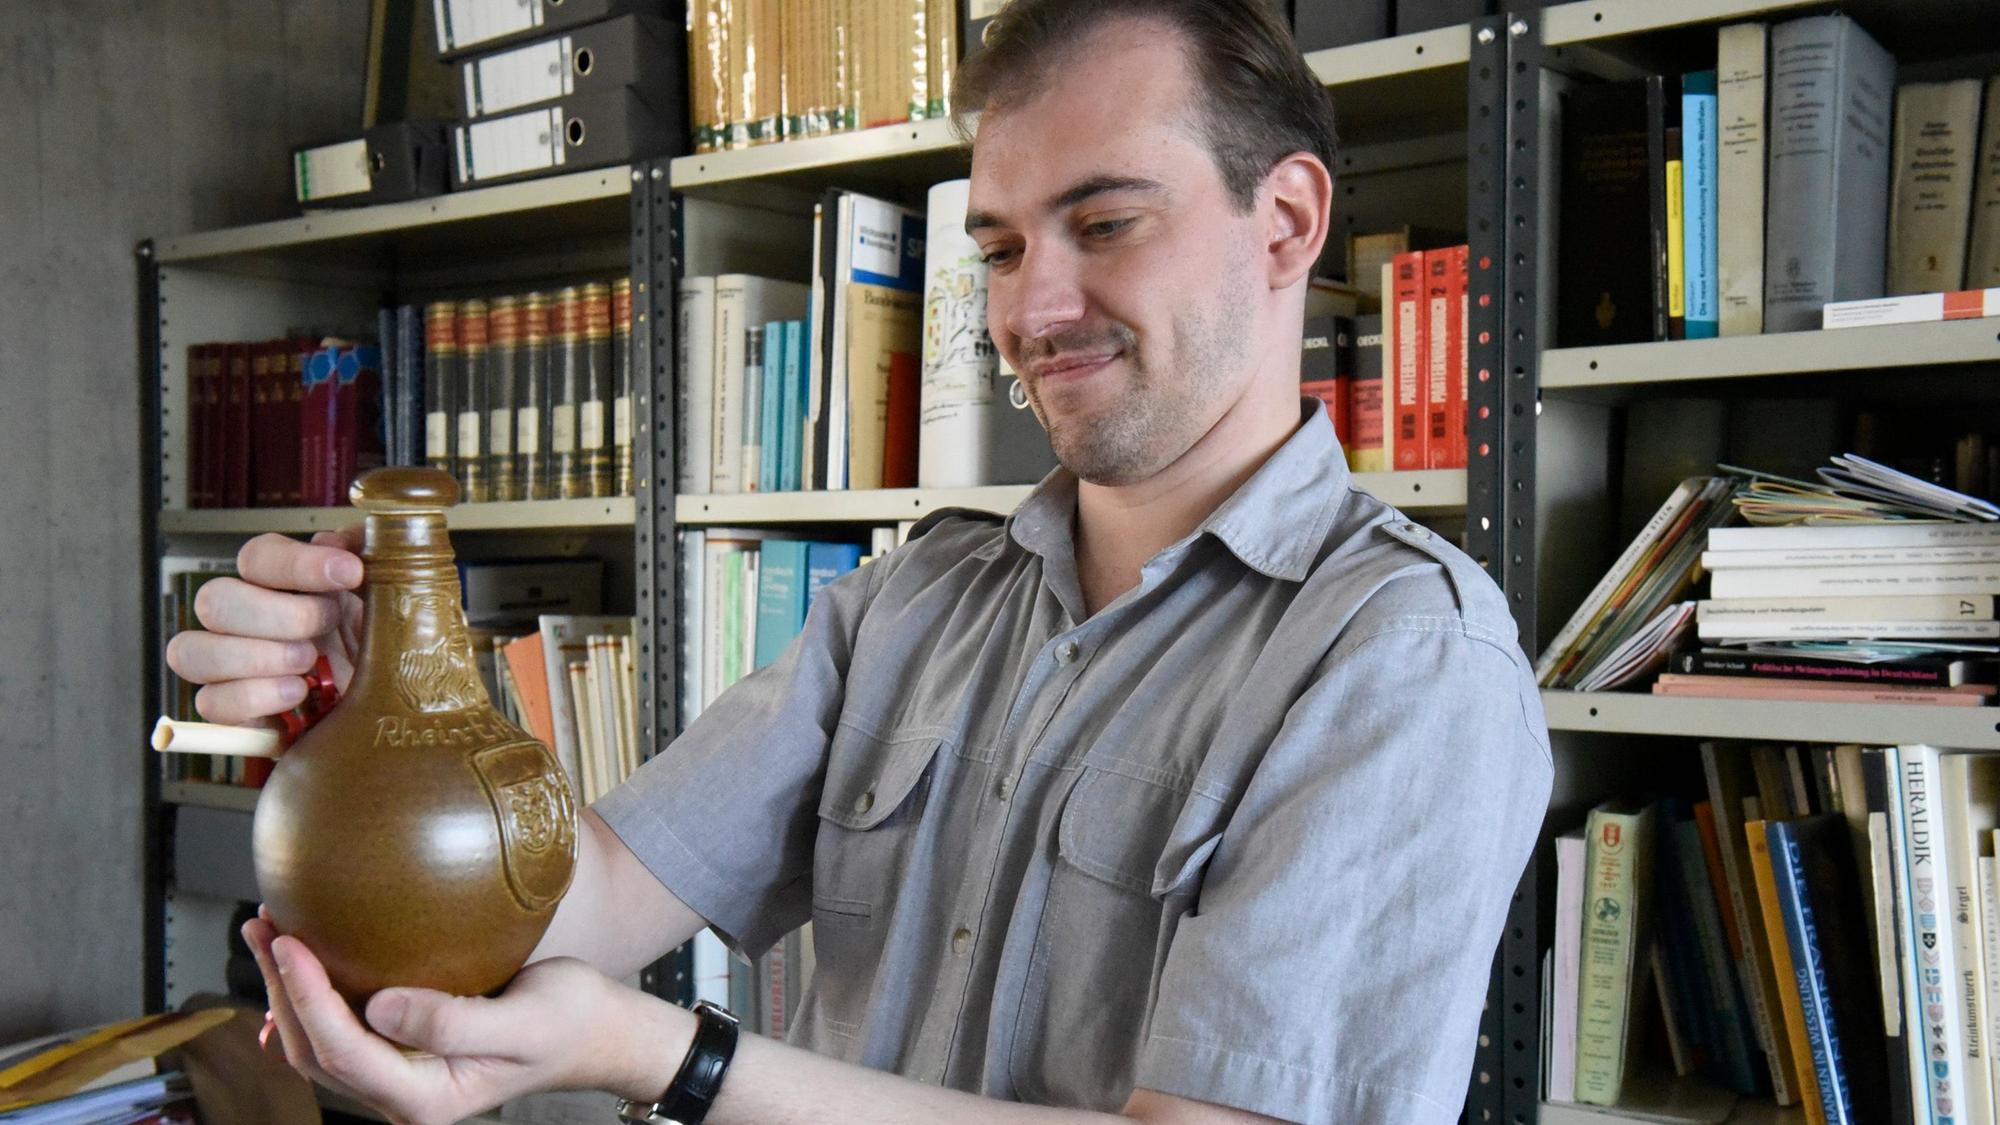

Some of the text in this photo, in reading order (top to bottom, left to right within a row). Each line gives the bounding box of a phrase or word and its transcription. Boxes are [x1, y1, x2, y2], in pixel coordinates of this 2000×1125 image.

[1698, 101, 1706, 186] Nordrhein-Westfalen
[1698, 188, 1708, 278] Kommunalverfassung
[1431, 287, 1447, 296] 2
[1698, 302, 1706, 316] Die
[1356, 334, 1383, 347] OECK
[1960, 601, 1975, 616] 17
[1752, 663, 1794, 674] Politische
[1795, 664, 1869, 679] Meinungsbildung
[1871, 669, 1881, 678] in
[1881, 668, 1939, 681] Deutschland
[1906, 761, 1932, 866] HERALDIK
[1788, 841, 1807, 895] DIE
[1803, 907, 1842, 1061] FRANKEN
[1956, 886, 1980, 1058] Kleinkunstwerk Siegel
[1796, 967, 1821, 1047] WESSELING
[1814, 1051, 1827, 1069] IN
